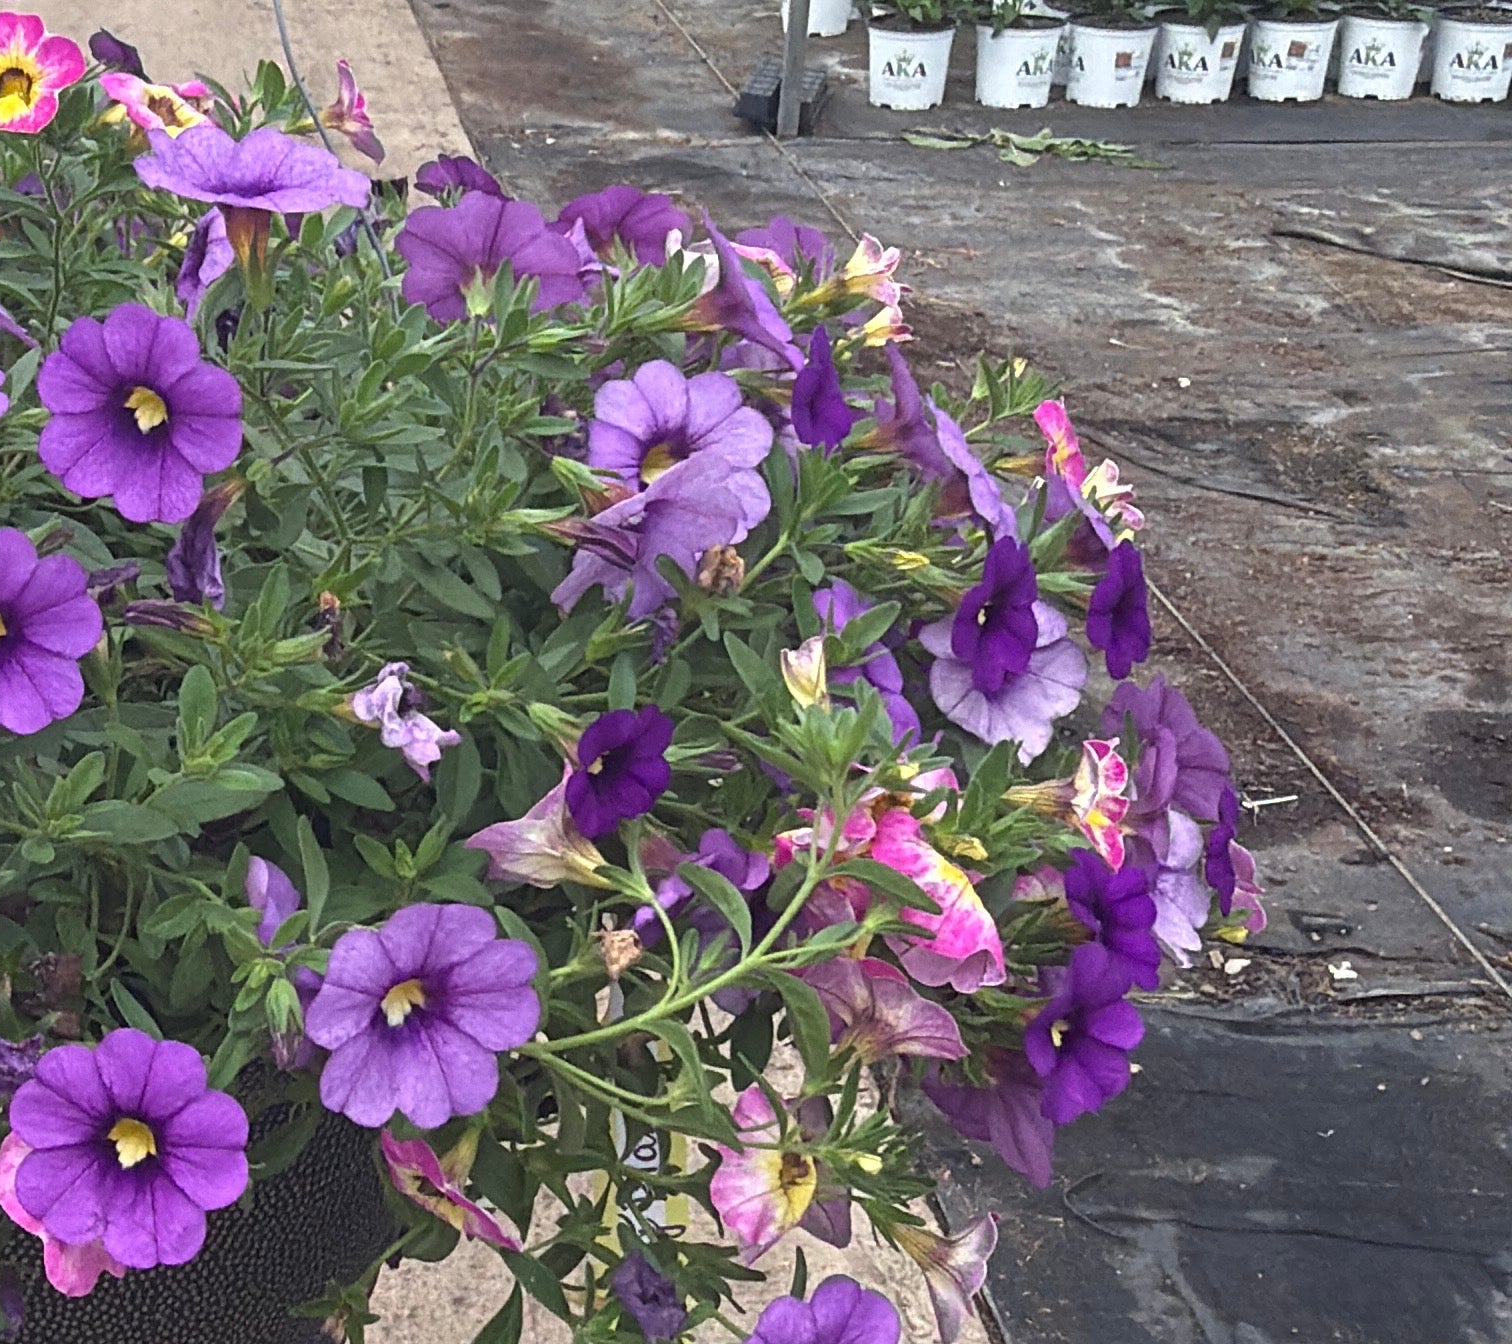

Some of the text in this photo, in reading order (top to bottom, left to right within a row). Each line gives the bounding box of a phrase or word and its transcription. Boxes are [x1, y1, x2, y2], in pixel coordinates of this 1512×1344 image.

[1164, 50, 1209, 72] AKA
[1349, 47, 1397, 67] AKA
[1450, 50, 1499, 70] AKA
[881, 59, 927, 77] AKA
